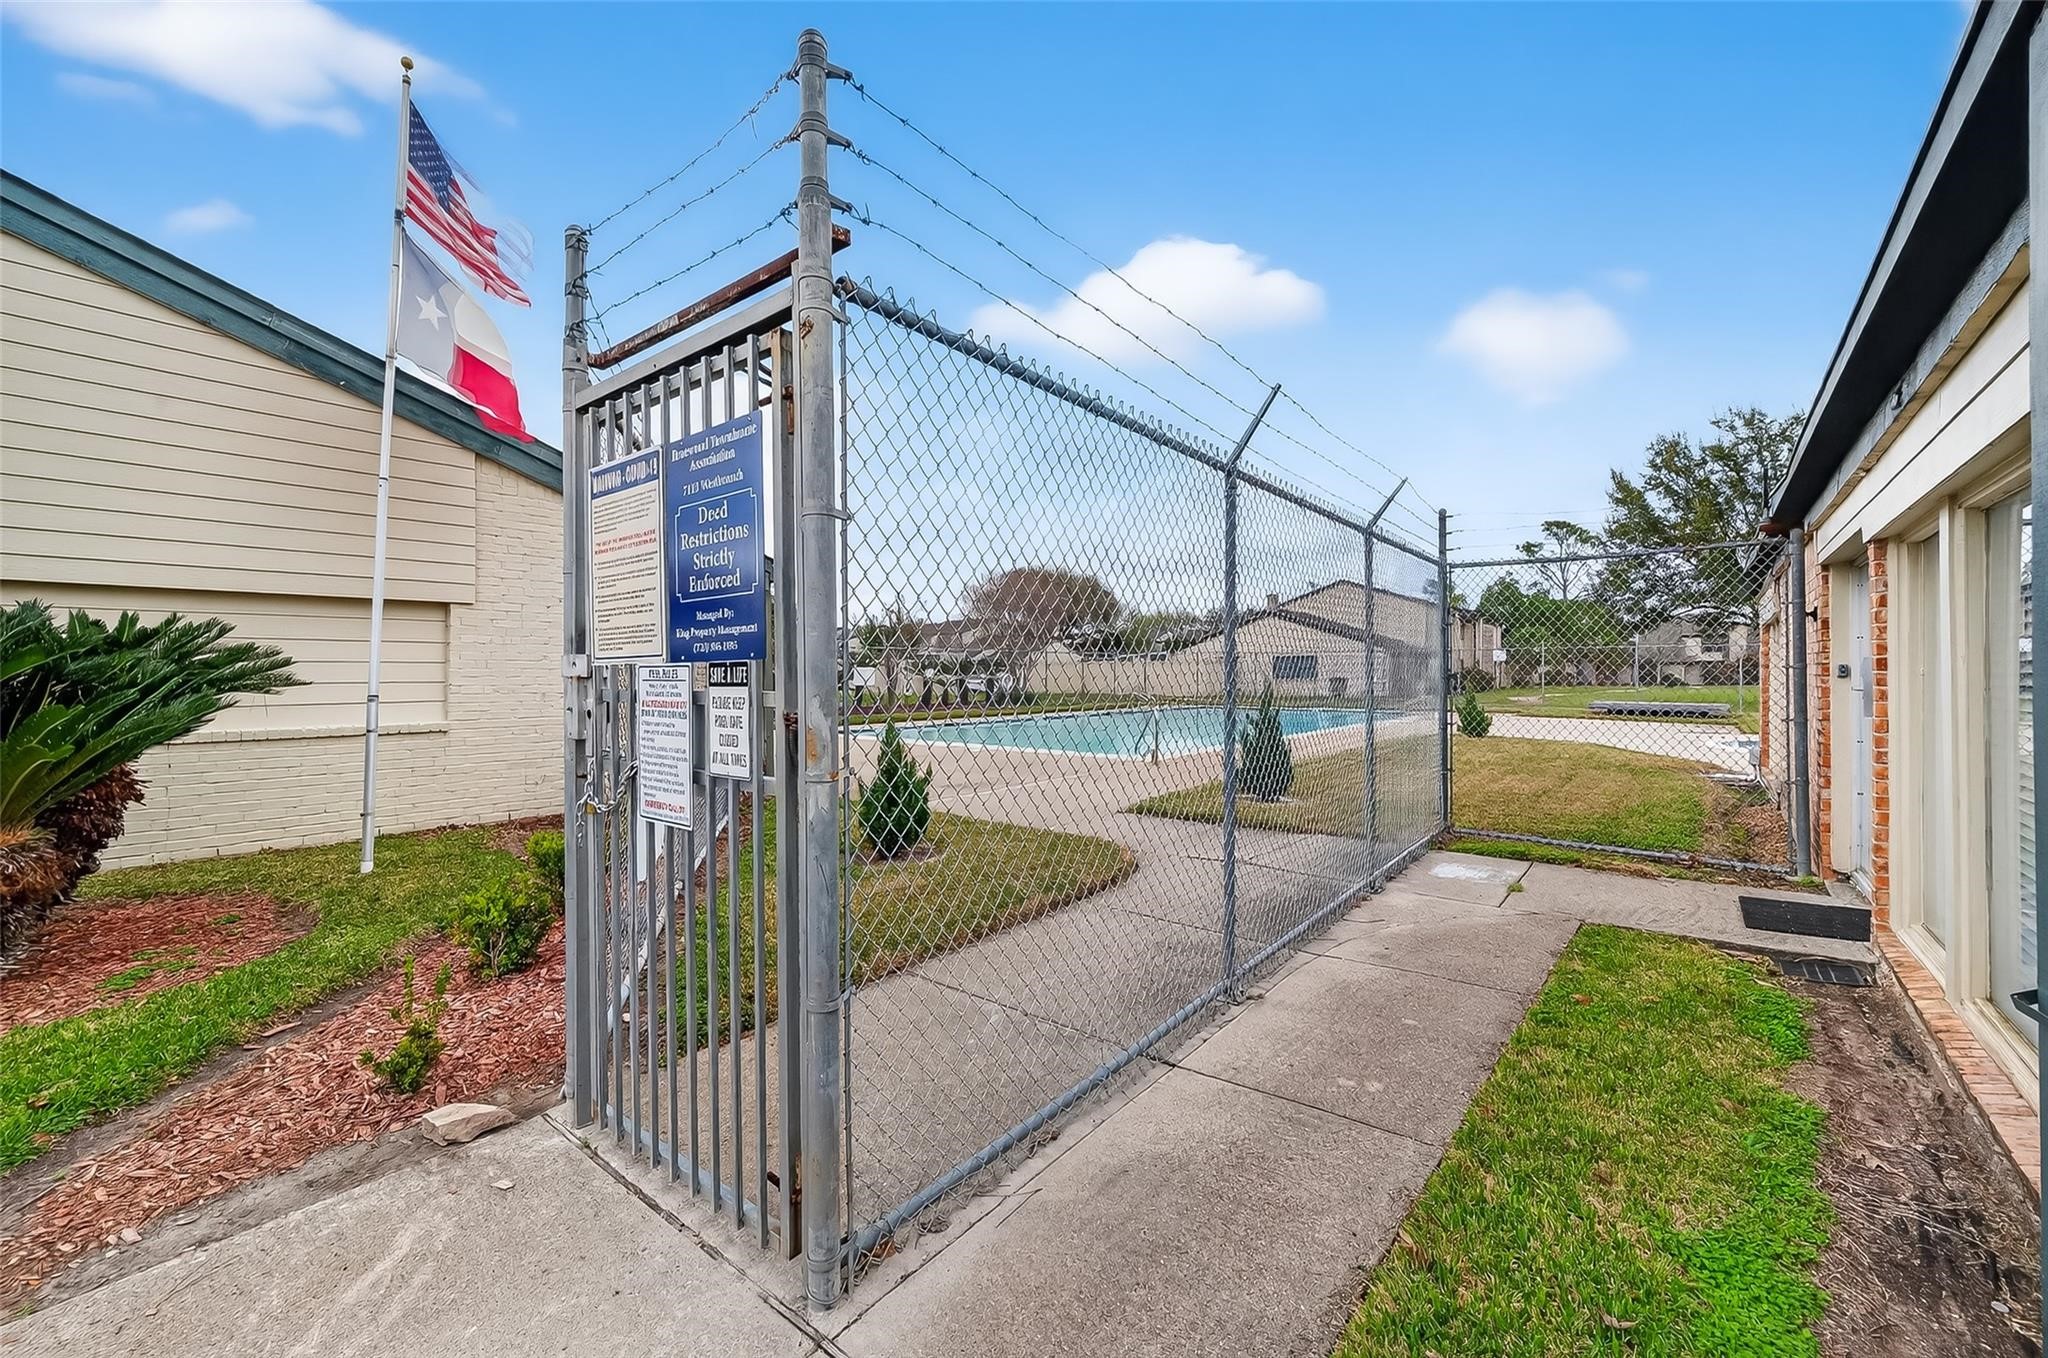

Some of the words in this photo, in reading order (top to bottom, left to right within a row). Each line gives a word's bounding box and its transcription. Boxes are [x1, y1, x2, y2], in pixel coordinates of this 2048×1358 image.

[709, 423, 758, 449] Townhome
[689, 448, 736, 473] Association
[697, 500, 728, 525] Deed
[680, 523, 750, 550] Restrictions
[693, 546, 736, 571] Strictly
[689, 568, 741, 593] Enforced
[696, 608, 723, 622] Managed
[690, 626, 717, 639] Property
[717, 623, 758, 636] Management
[710, 666, 726, 684] SAVE
[733, 666, 748, 684] LIFE
[712, 696, 732, 711] PLEASE
[732, 696, 746, 711] KEEP
[714, 714, 729, 729] POOL
[719, 733, 739, 748] CLOSED
[712, 751, 719, 764] AT
[719, 752, 730, 766] ALL
[730, 753, 748, 768] TIMES
